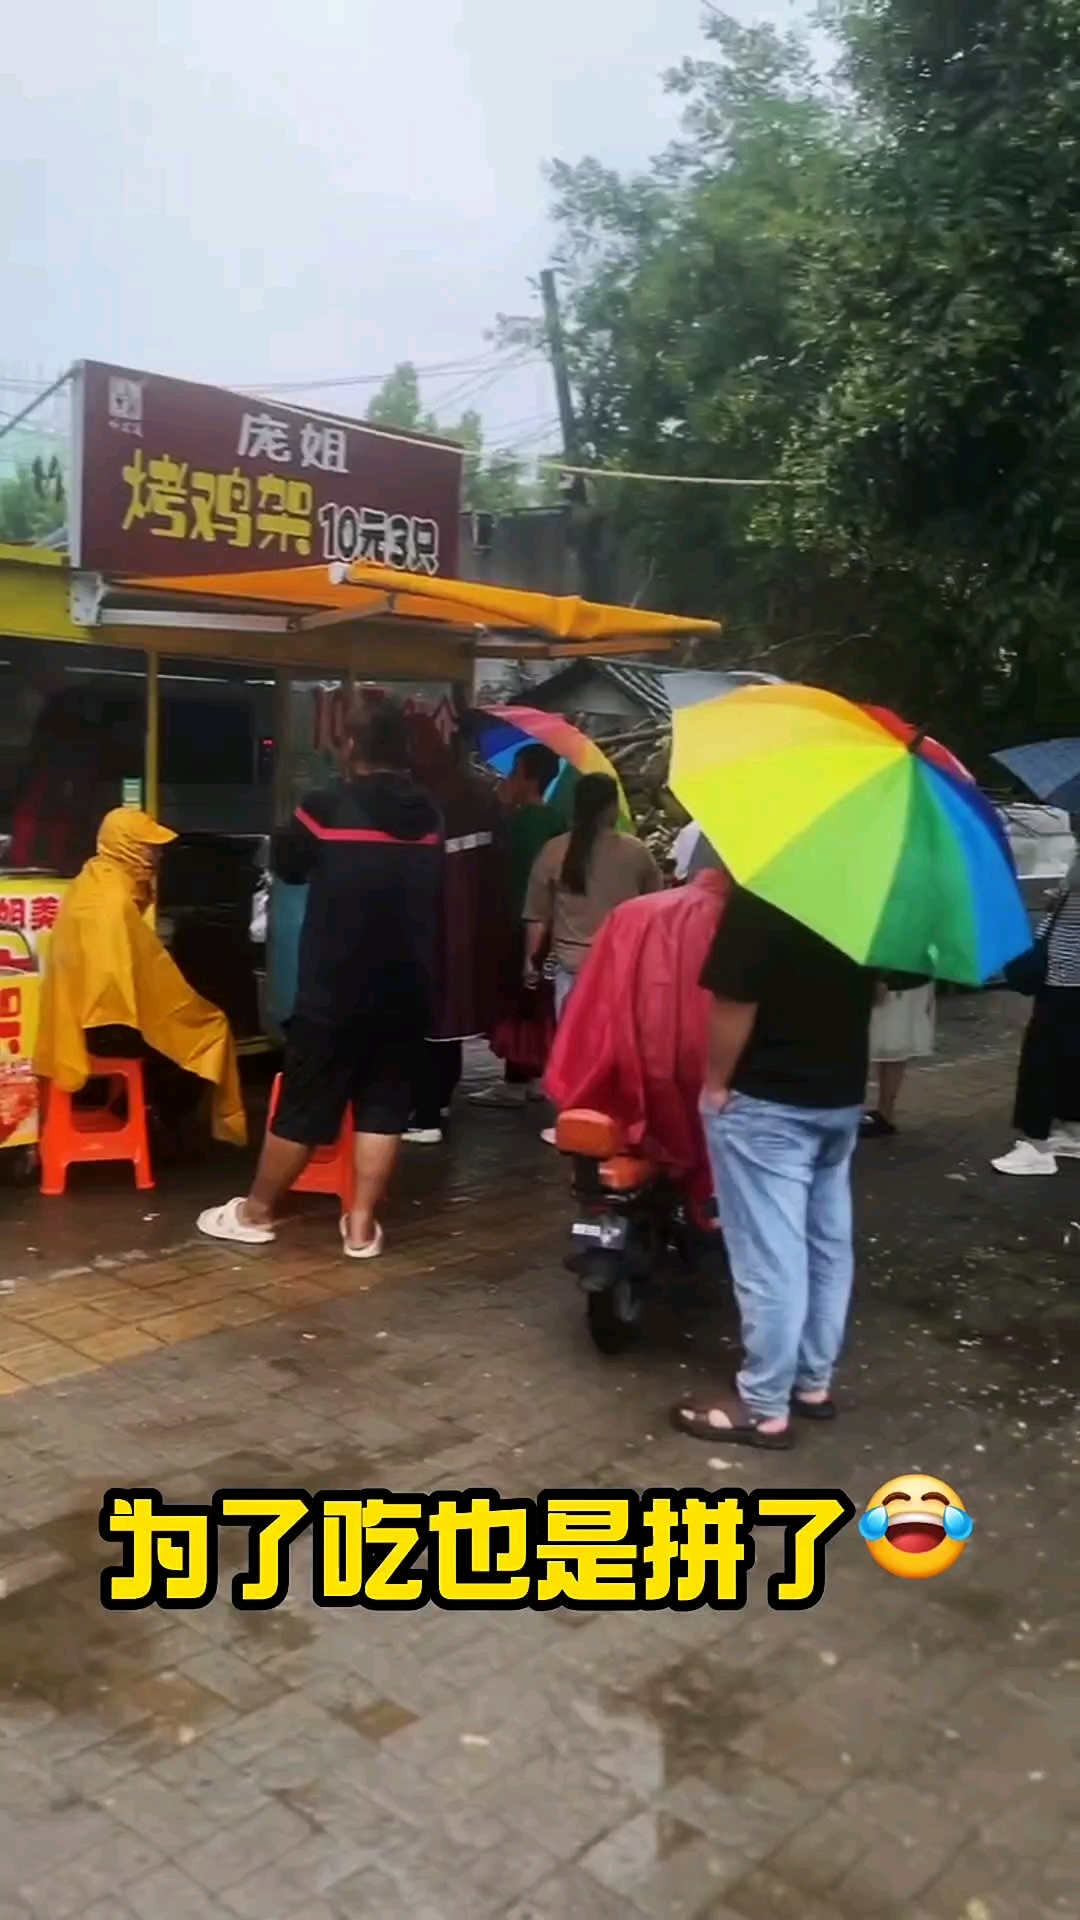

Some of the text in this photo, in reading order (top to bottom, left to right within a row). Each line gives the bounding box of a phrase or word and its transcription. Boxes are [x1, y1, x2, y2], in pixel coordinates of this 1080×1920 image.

[238, 413, 349, 473] 庞姐
[122, 448, 439, 575] 烤鸡架 10元3只
